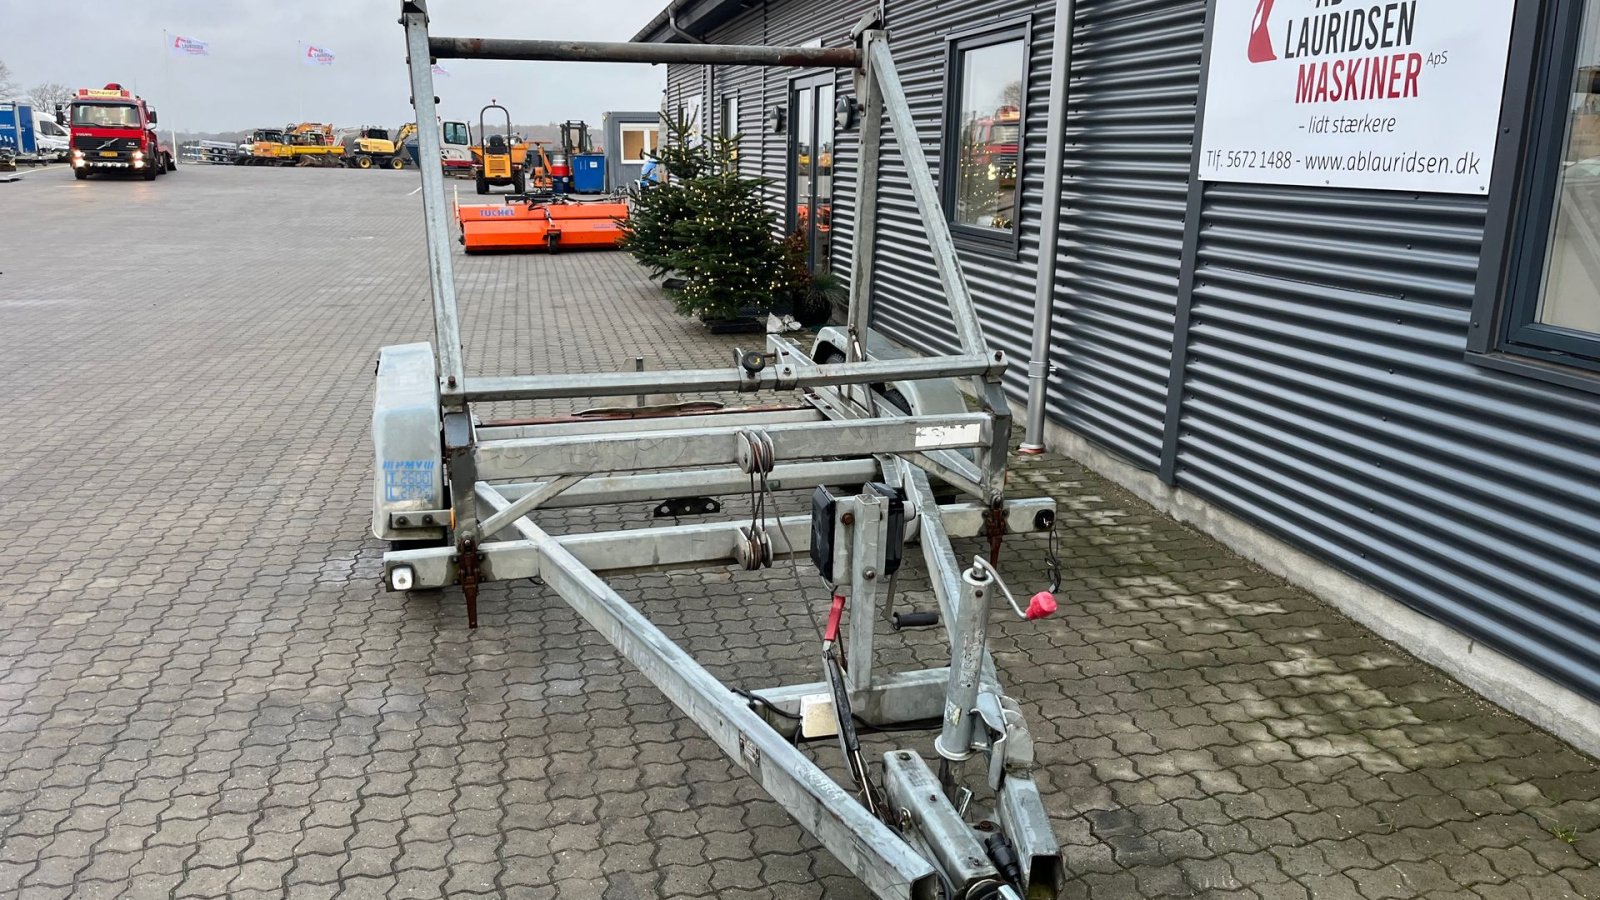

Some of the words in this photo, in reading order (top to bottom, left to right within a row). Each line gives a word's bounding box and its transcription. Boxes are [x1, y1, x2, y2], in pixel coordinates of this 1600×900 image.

[1284, 0, 1416, 59] LAURIDSEN
[1295, 52, 1422, 104] MASKINER
[1426, 51, 1448, 68] ApS
[1308, 115, 1329, 134] lidt
[1332, 114, 1396, 134] stærkere
[1207, 150, 1223, 172] Tlf.
[1227, 150, 1256, 168] 5672
[1259, 151, 1292, 169] 1488
[1305, 151, 1480, 175] www.ablauridsen.dk
